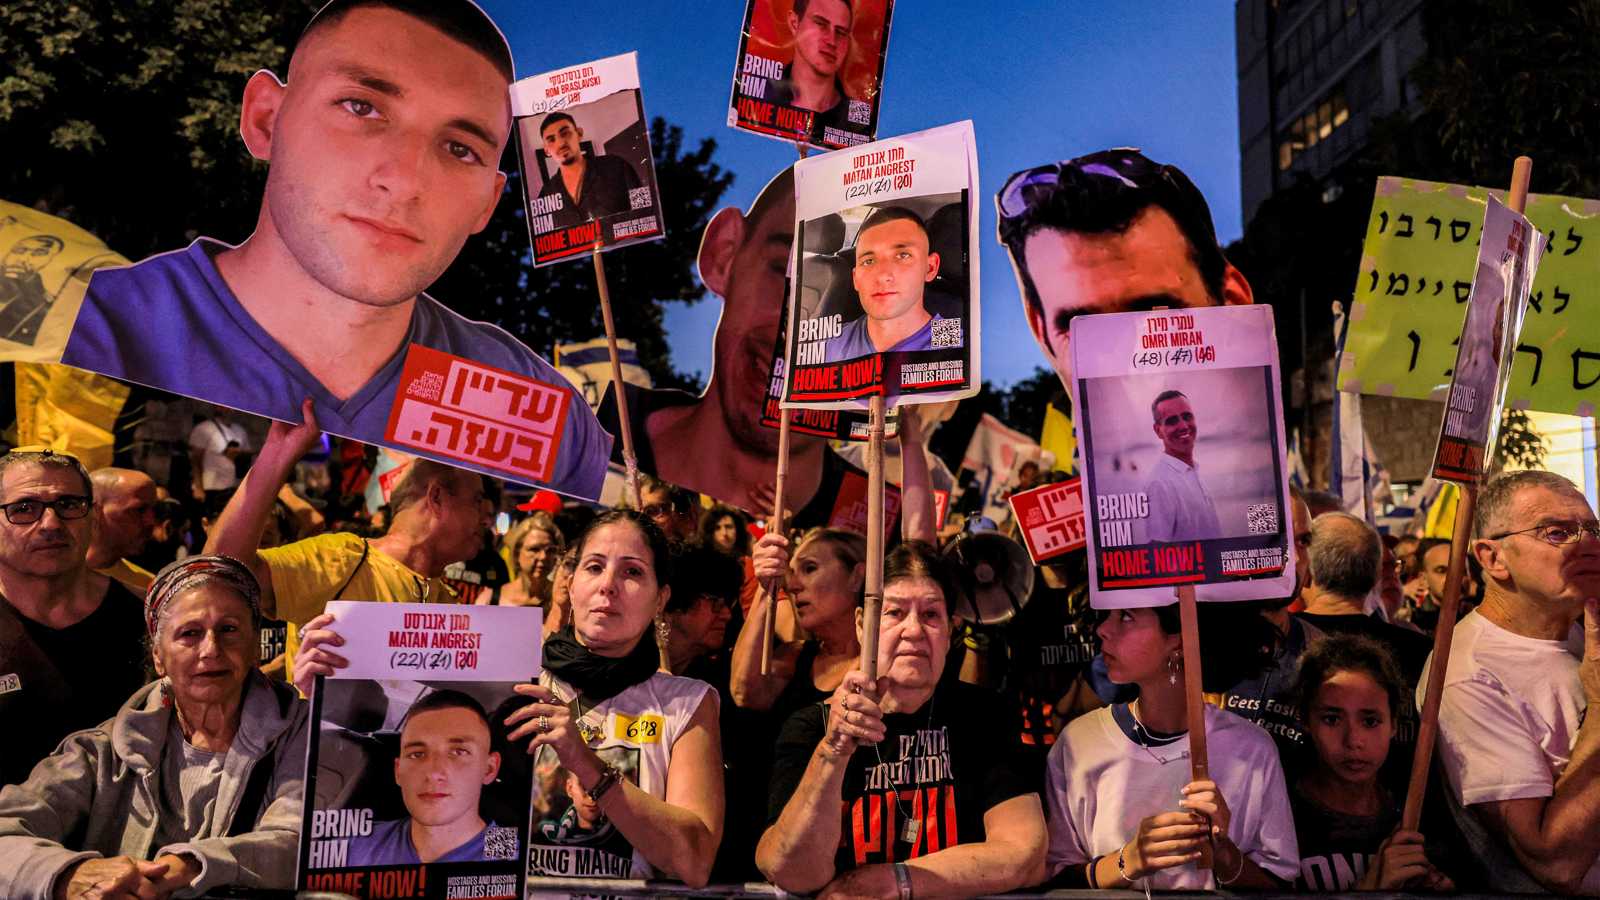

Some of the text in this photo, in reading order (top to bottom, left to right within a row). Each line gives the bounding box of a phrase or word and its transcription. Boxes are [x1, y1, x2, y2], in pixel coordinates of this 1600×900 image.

[743, 53, 784, 80] BRING
[545, 76, 600, 98] ROM BRASLAVSKI
[740, 74, 767, 99] HIM
[737, 96, 815, 135] HOME NOW!
[853, 147, 904, 169] מתן אנגרסט
[843, 160, 915, 185] MATAN ANGREST
[894, 173, 912, 190] (20)
[530, 192, 563, 216] BRING
[533, 212, 554, 235] HIM
[535, 217, 603, 253] HOME NOW!
[1379, 211, 1483, 246] סרבו
[1526, 286, 1570, 314] לא
[798, 313, 842, 341] BRING
[1147, 315, 1194, 333] עמרי מירן
[1142, 331, 1203, 349] OMRI MIRAN
[796, 341, 826, 365] HIM
[1133, 351, 1162, 368] (48)
[793, 366, 839, 391] HOME
[841, 354, 882, 389] NOW!
[901, 360, 963, 373] HOSTAGES AND MISSING
[901, 368, 963, 385] FAMILIES FORUM
[451, 367, 558, 423] עדיין
[1450, 384, 1476, 412] BRING
[1445, 410, 1464, 438] HIM
[411, 412, 544, 473] בעזה.
[1044, 487, 1083, 518] דיין
[1097, 492, 1149, 520] BRING
[1100, 521, 1133, 548] HIM
[1102, 542, 1205, 577] HOME NOW!
[1221, 547, 1282, 560] HOSTAGES AND MISSING
[1222, 556, 1282, 573] FAMILIES FORUM
[404, 612, 470, 632] מתן אנגרסט
[389, 631, 482, 649] MATAN ANGREST
[455, 650, 478, 669] (20)
[1228, 695, 1261, 710] Gets
[626, 720, 657, 738] 698
[311, 808, 373, 839] BRING
[308, 839, 349, 869] HIM
[529, 848, 570, 874] RING
[306, 865, 427, 899] HOME NOW!
[447, 883, 517, 900] FAMILIES FORUM
[448, 873, 517, 886] HOSTAGES AND MISSING
